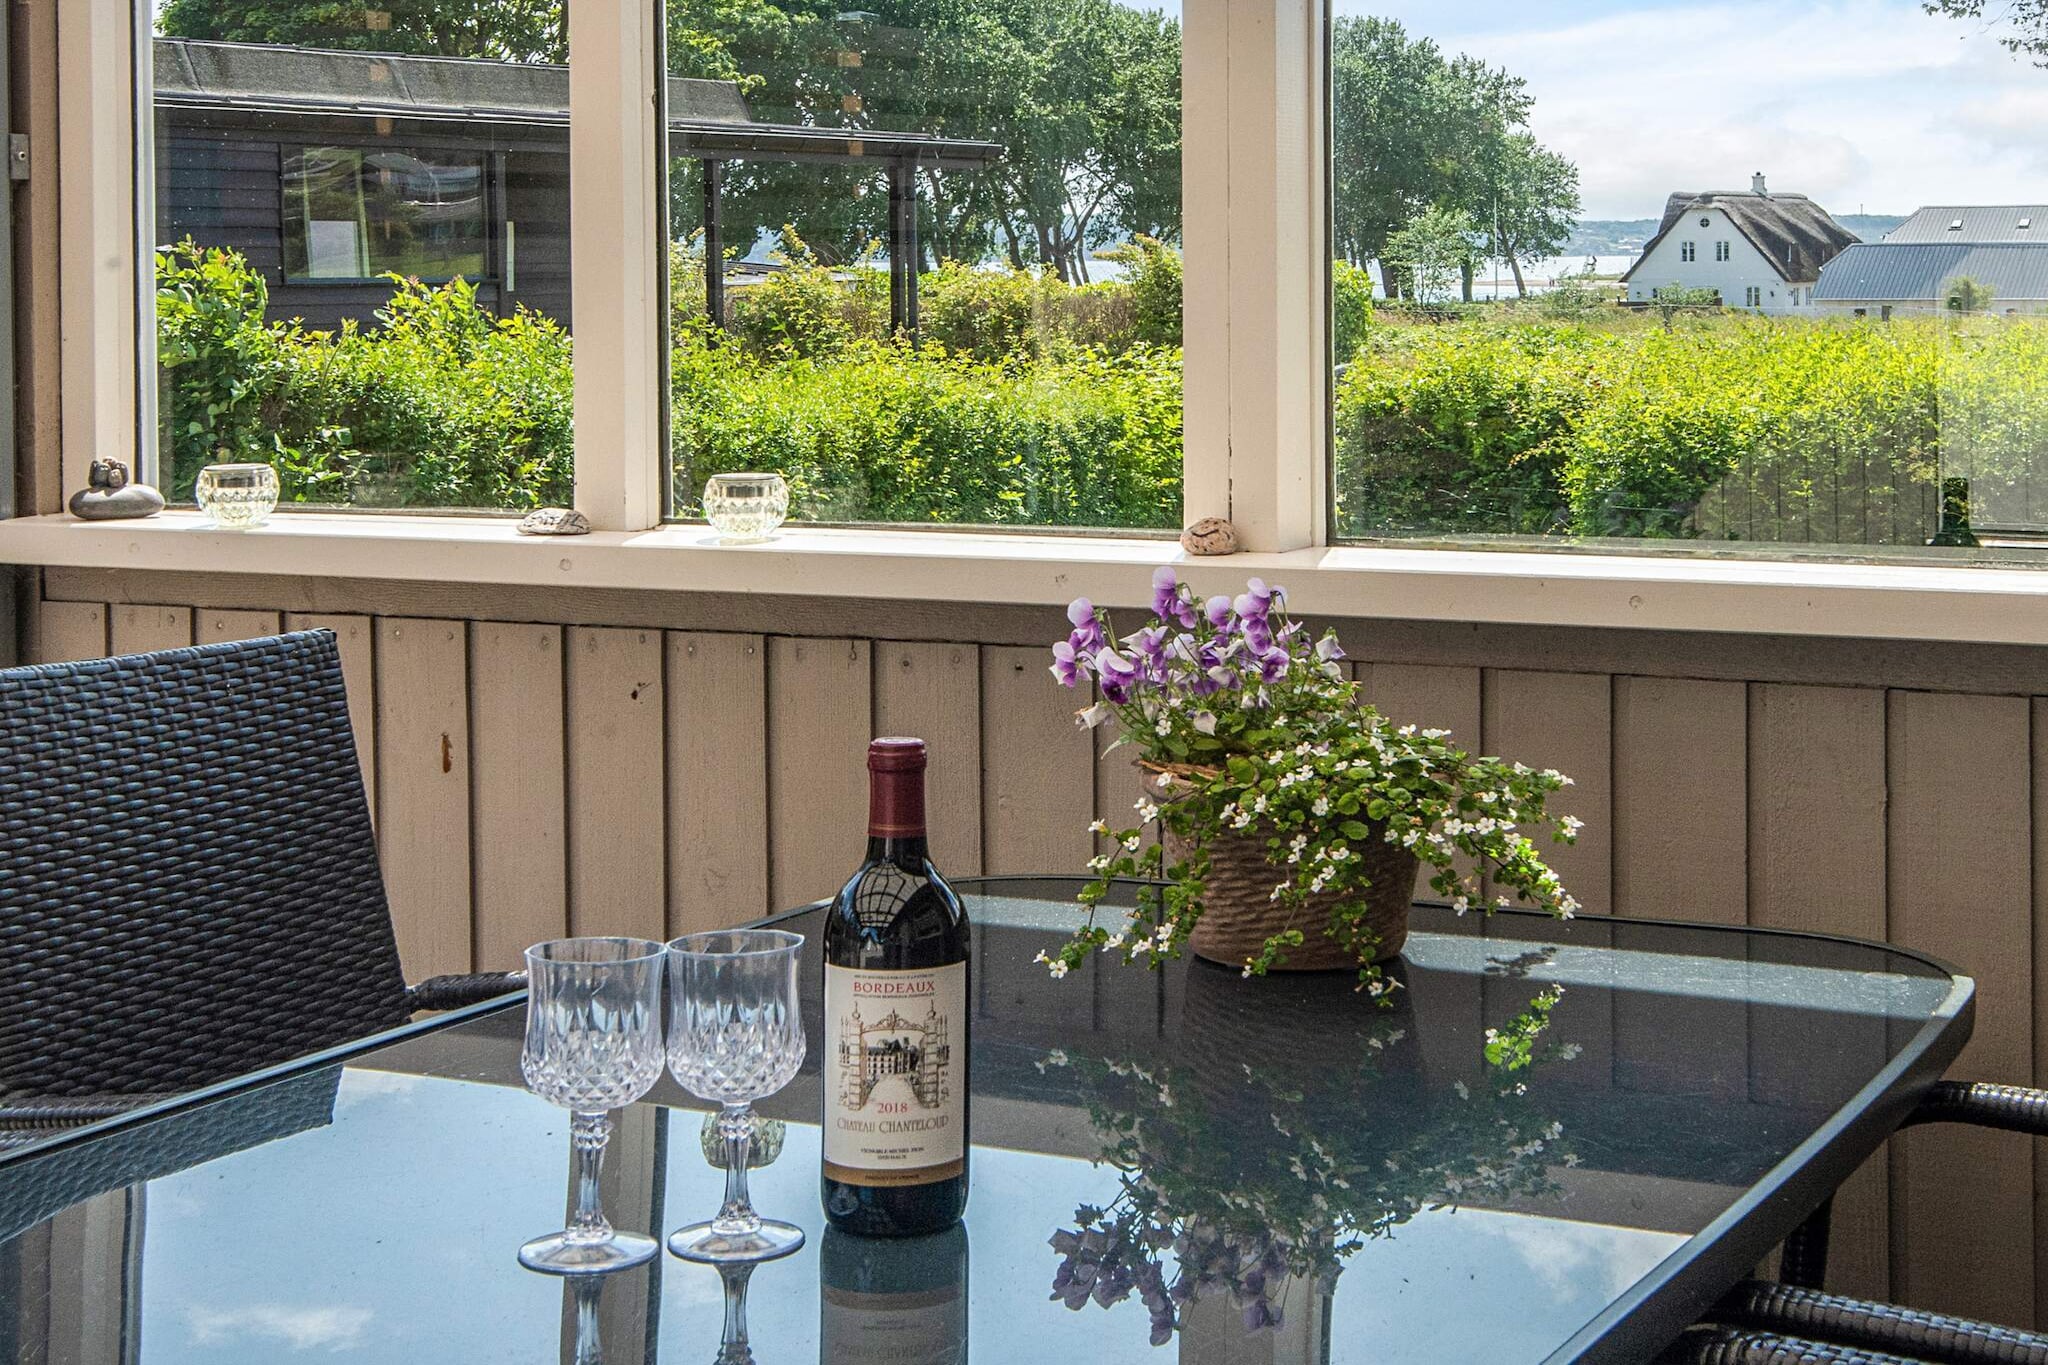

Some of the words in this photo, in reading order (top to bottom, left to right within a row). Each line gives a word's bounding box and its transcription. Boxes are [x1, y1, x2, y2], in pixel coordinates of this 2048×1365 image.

[853, 980, 935, 994] BORDEAUX
[877, 1103, 908, 1113] 2018
[879, 1115, 948, 1133] CHANTELOUP
